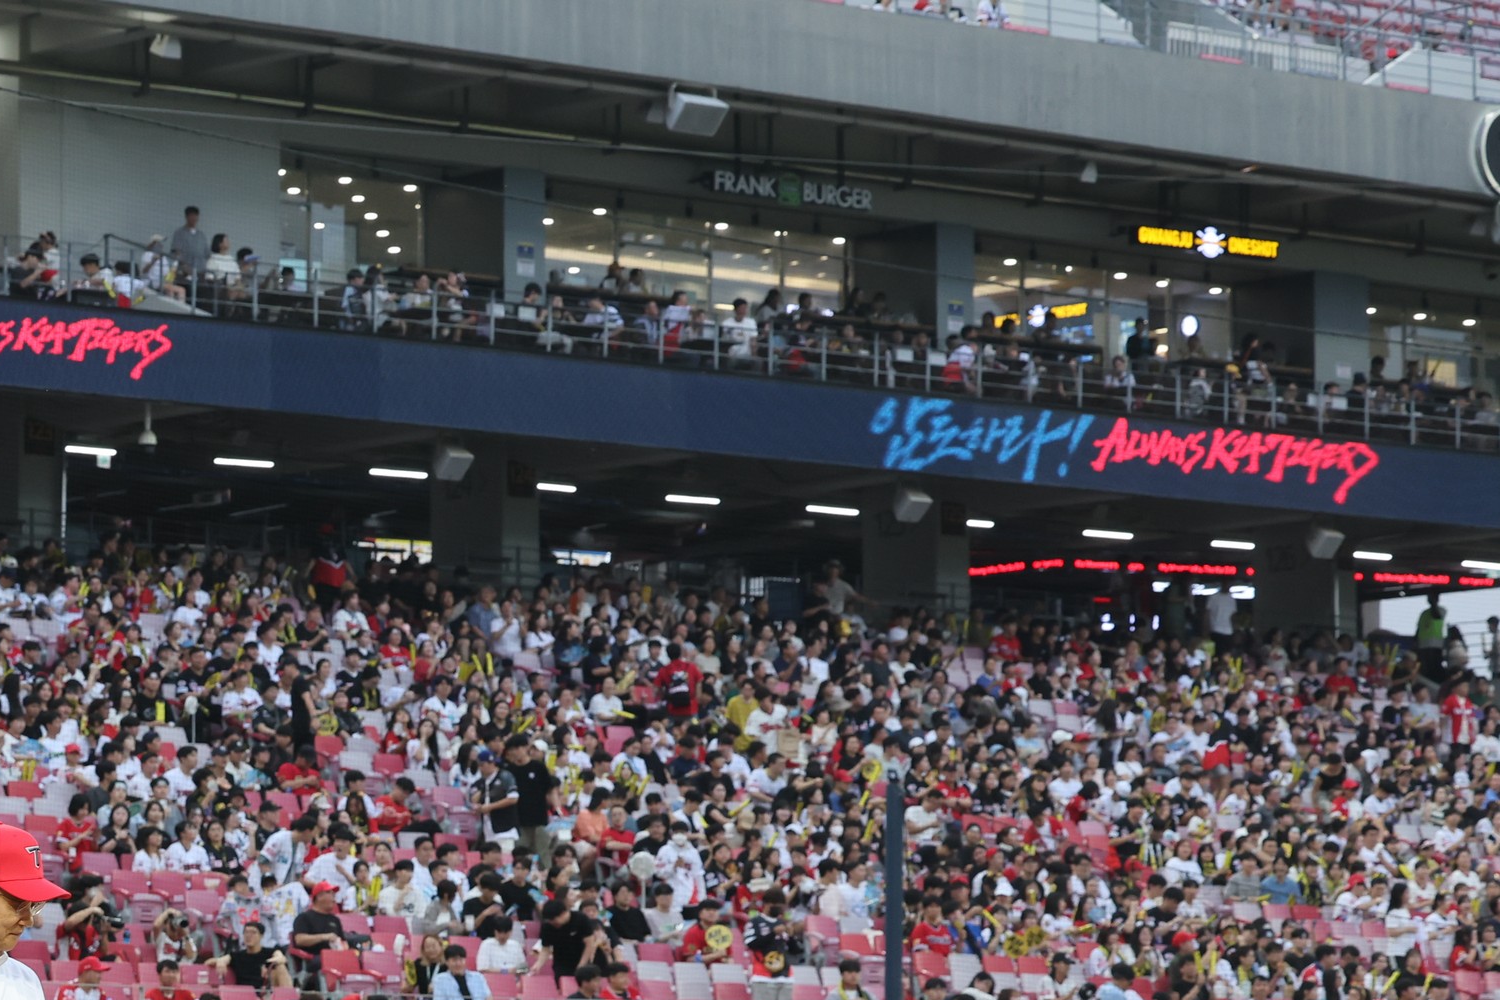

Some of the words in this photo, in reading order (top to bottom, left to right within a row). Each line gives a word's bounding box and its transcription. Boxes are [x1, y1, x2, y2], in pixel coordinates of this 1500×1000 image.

[714, 170, 777, 198] FRANK
[803, 181, 873, 211] BURGER
[67, 318, 173, 381] TIGERS
[1090, 417, 1206, 474] ALWAYS
